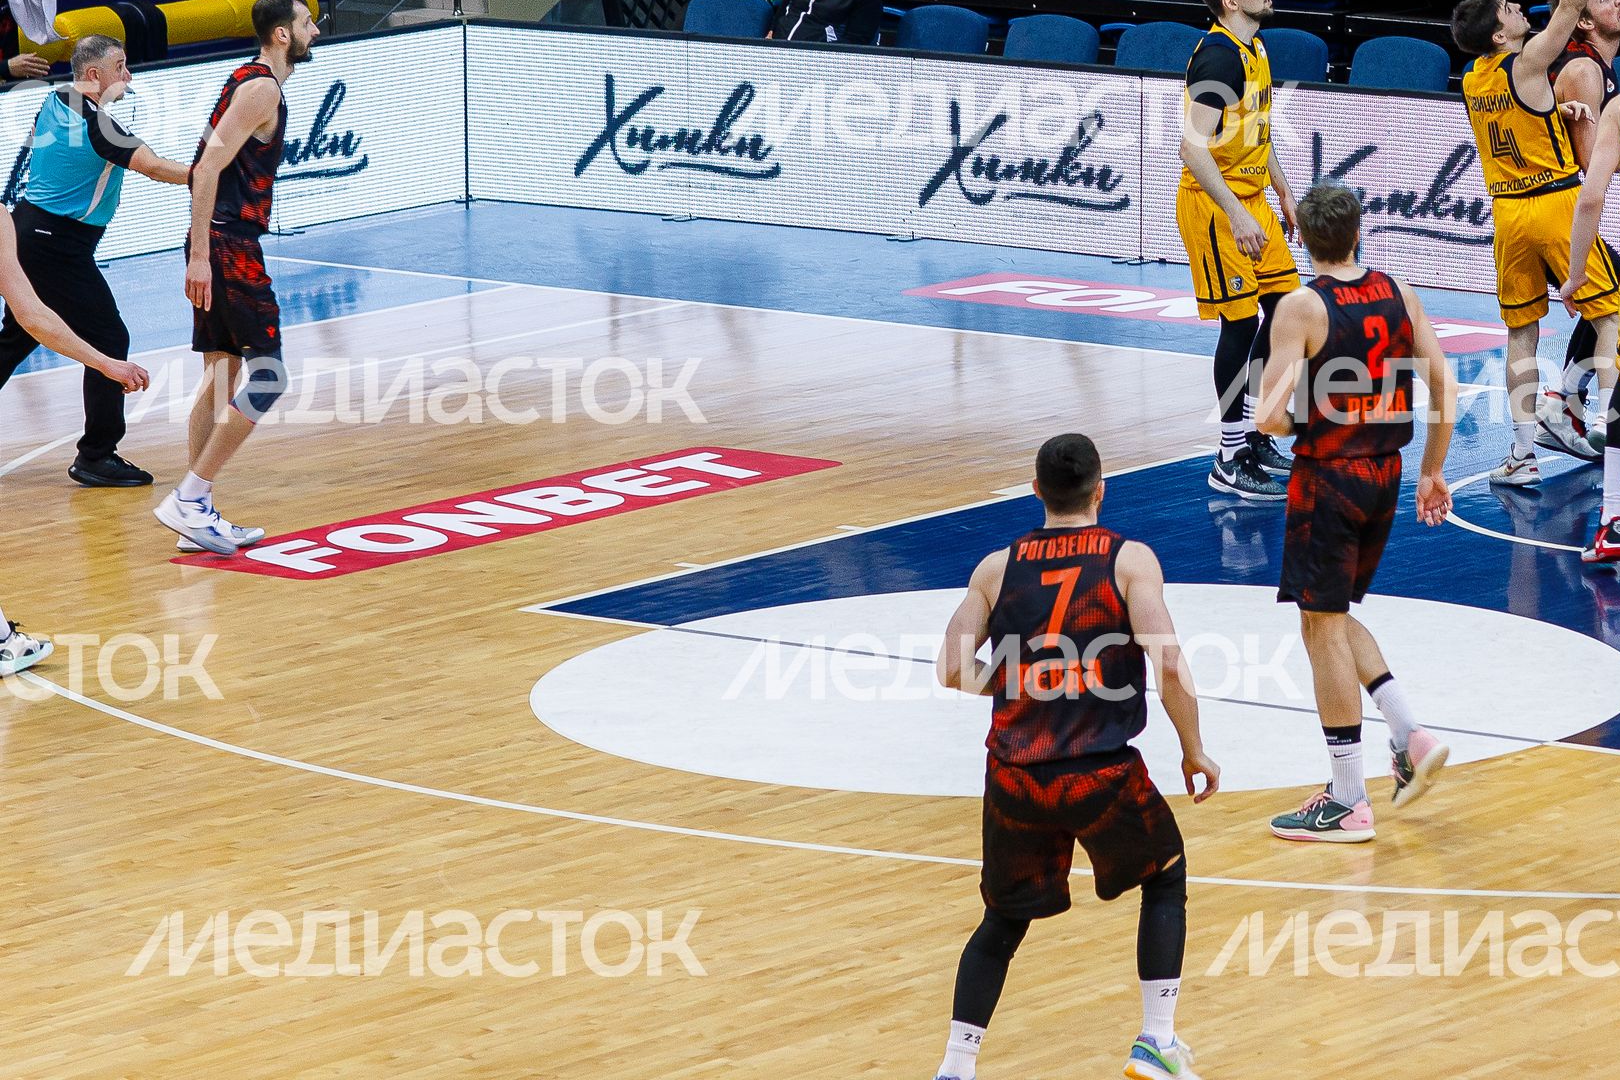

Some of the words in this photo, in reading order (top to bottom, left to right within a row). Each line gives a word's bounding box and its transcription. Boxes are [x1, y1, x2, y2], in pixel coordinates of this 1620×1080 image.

[1488, 120, 1528, 169] 4
[1363, 315, 1391, 380] 2
[1347, 386, 1408, 423] РЕВДА
[244, 450, 764, 575] FONBET
[1016, 534, 1112, 562] РОГОЗЕНКО
[1040, 566, 1083, 650] 7
[1018, 658, 1104, 694] РЕВДА
